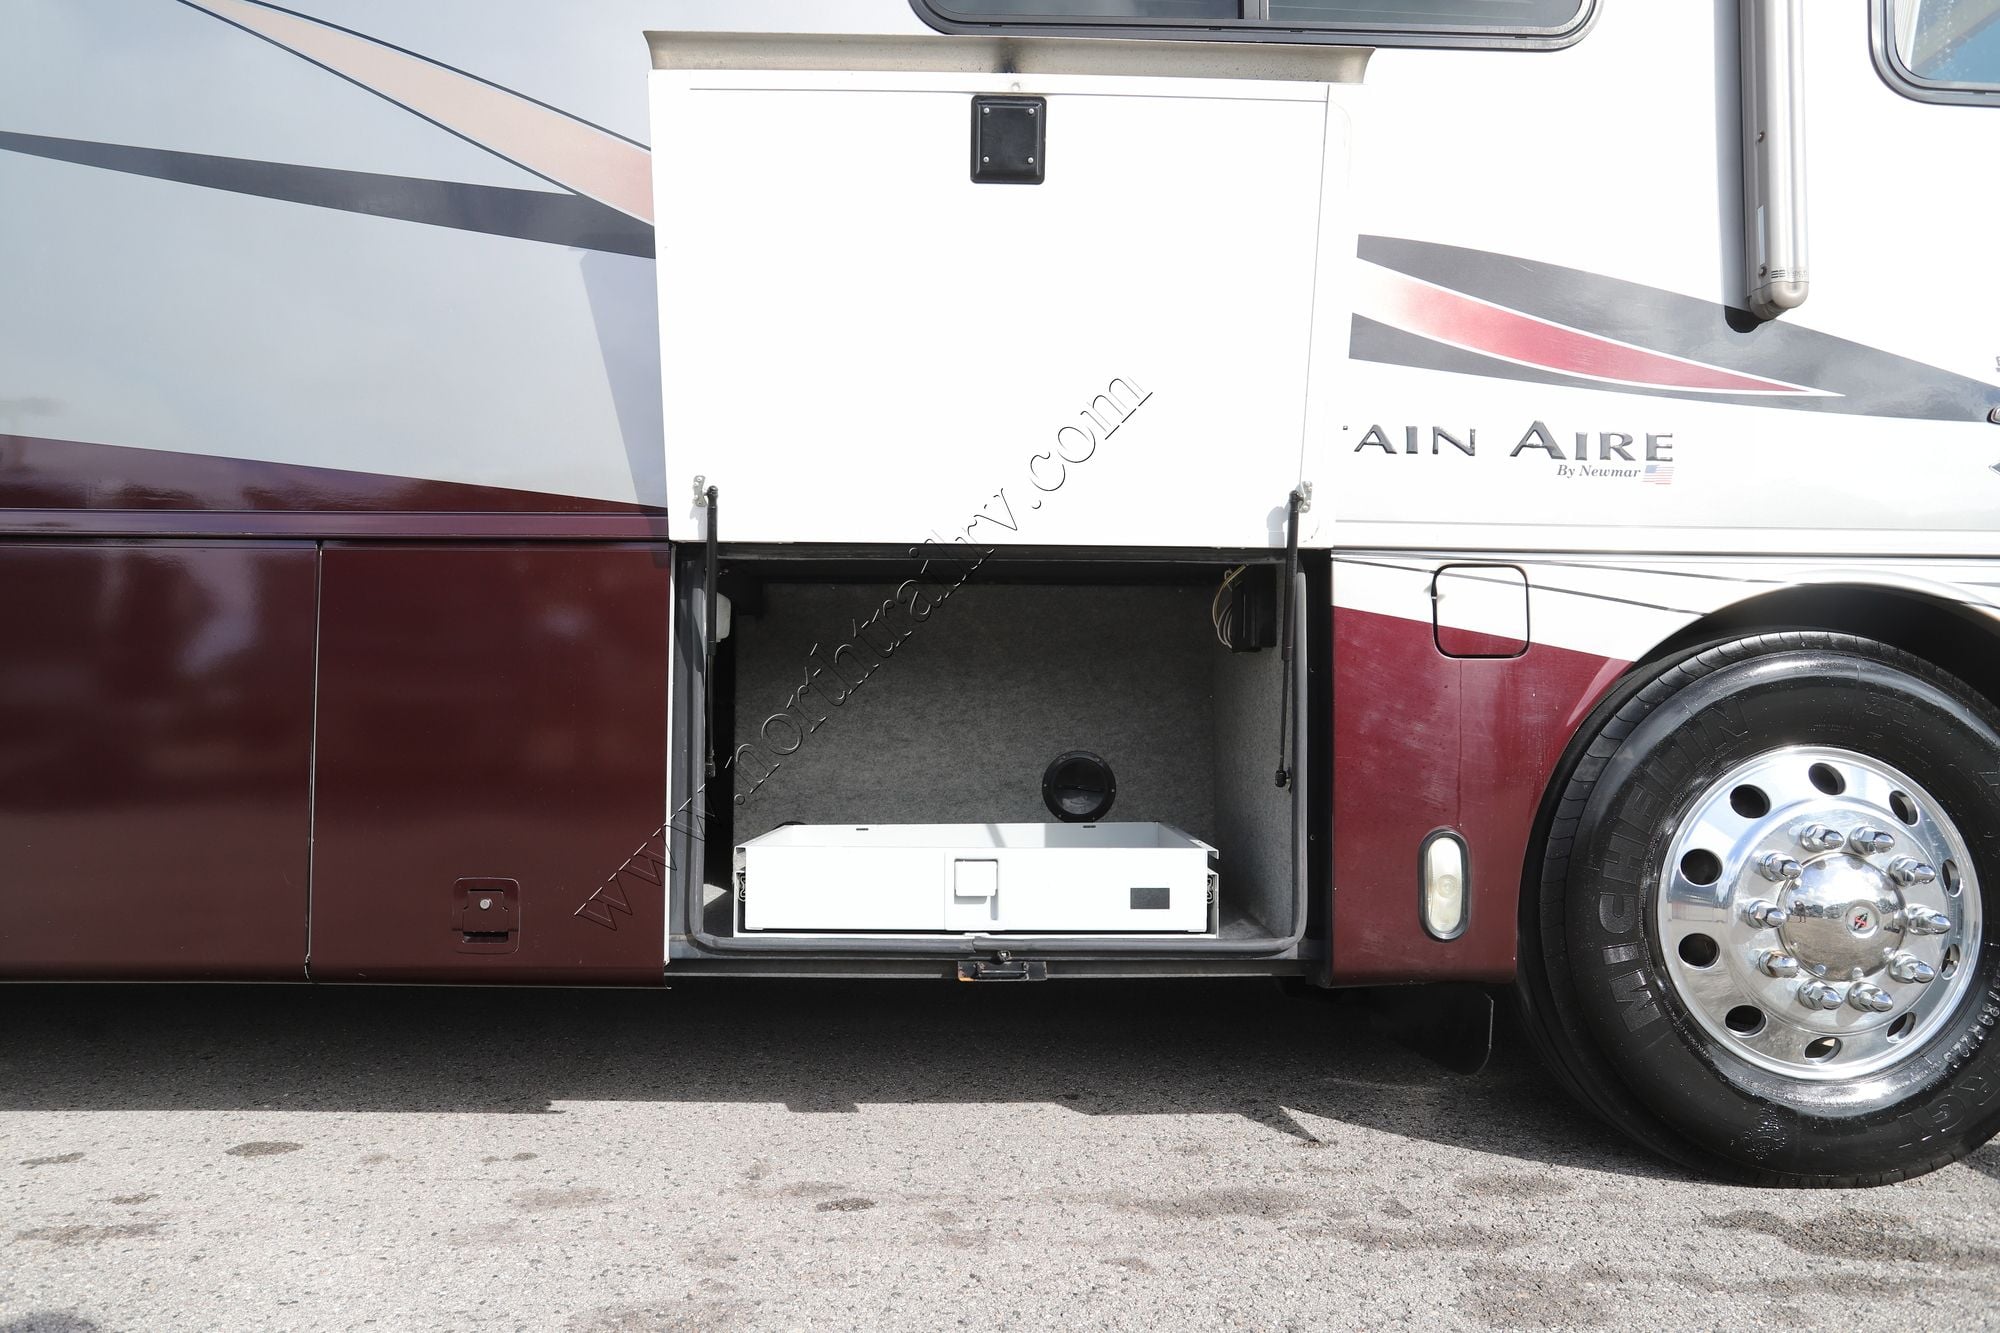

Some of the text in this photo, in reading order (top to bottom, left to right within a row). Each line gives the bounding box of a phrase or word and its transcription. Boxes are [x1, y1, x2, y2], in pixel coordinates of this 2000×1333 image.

[1343, 420, 1673, 461] AIN AIRE
[1556, 464, 1642, 479] By Newmar
[1599, 696, 1750, 1032] MICHELIN
